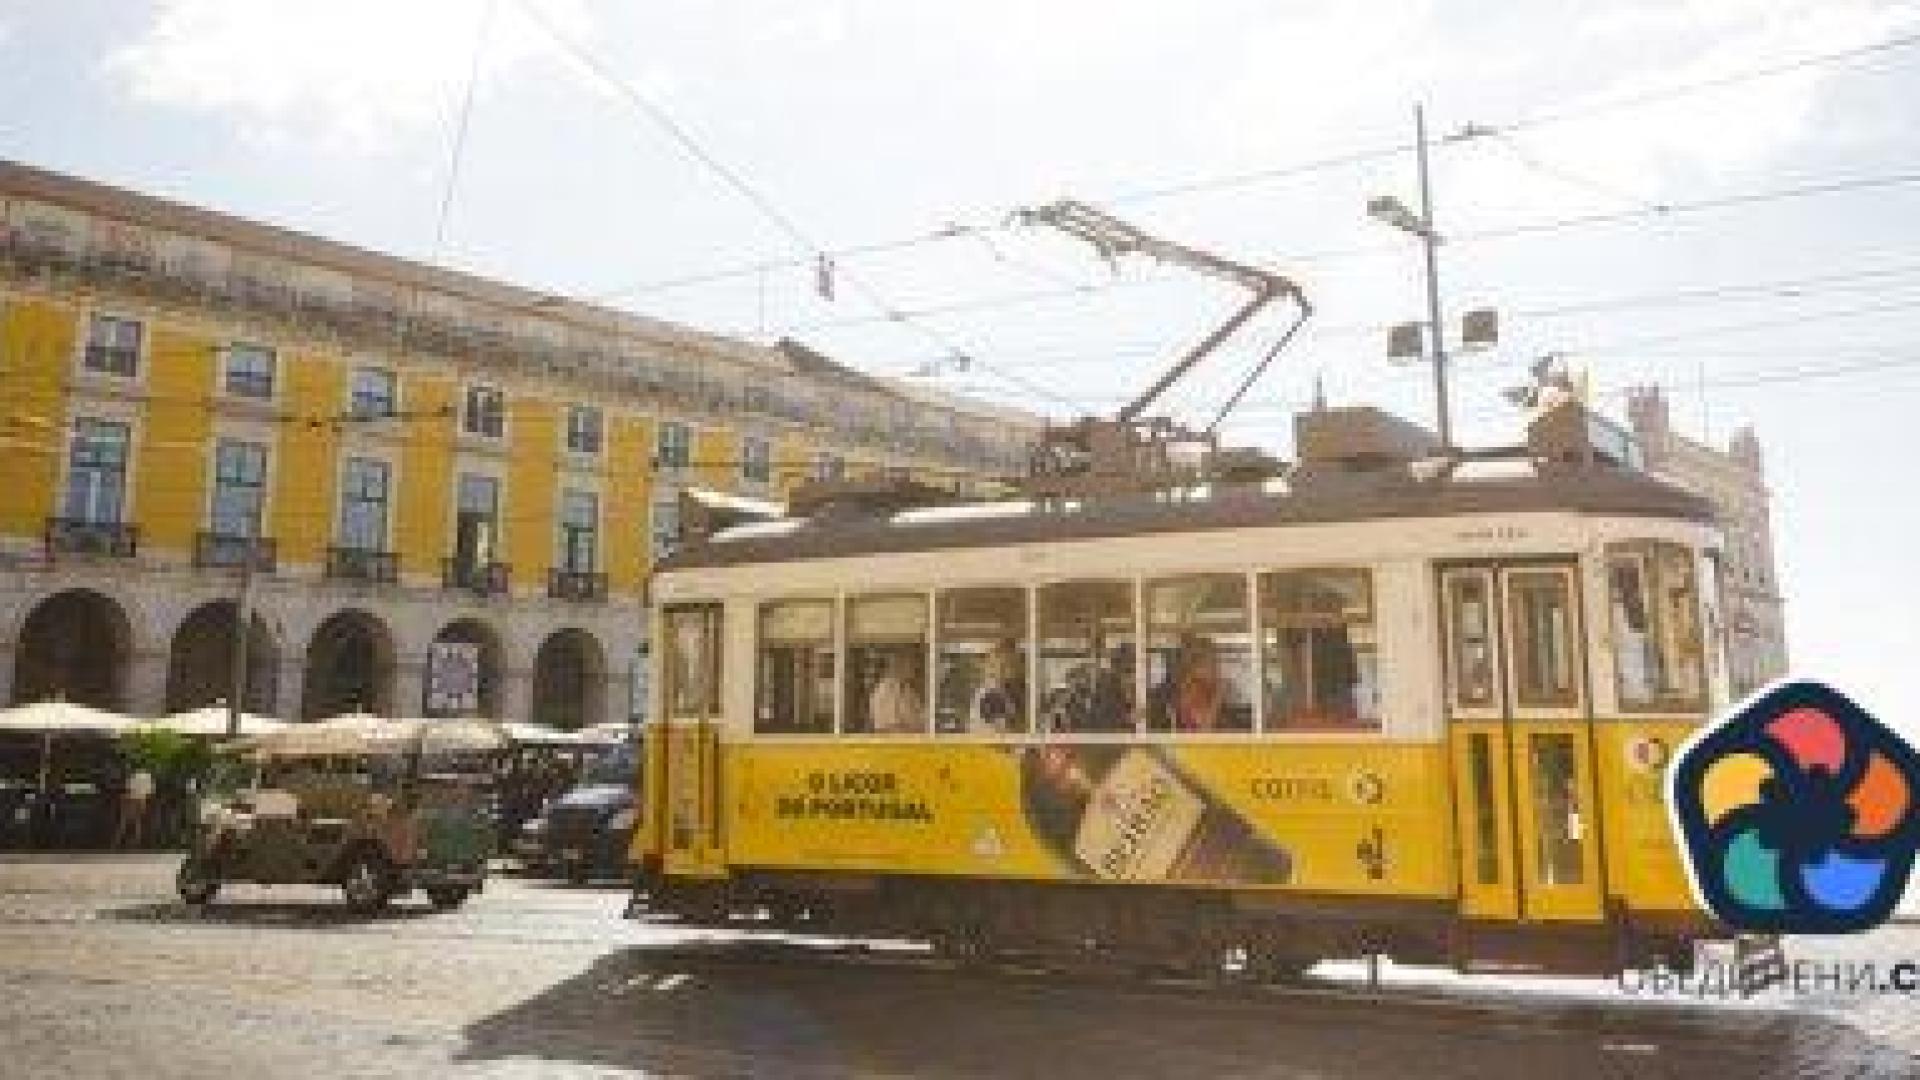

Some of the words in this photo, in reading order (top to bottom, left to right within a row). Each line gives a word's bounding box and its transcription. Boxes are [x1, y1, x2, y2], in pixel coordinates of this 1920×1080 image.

[808, 772, 825, 795] O
[828, 772, 896, 796] LICOR
[810, 797, 934, 823] PORTUGAL
